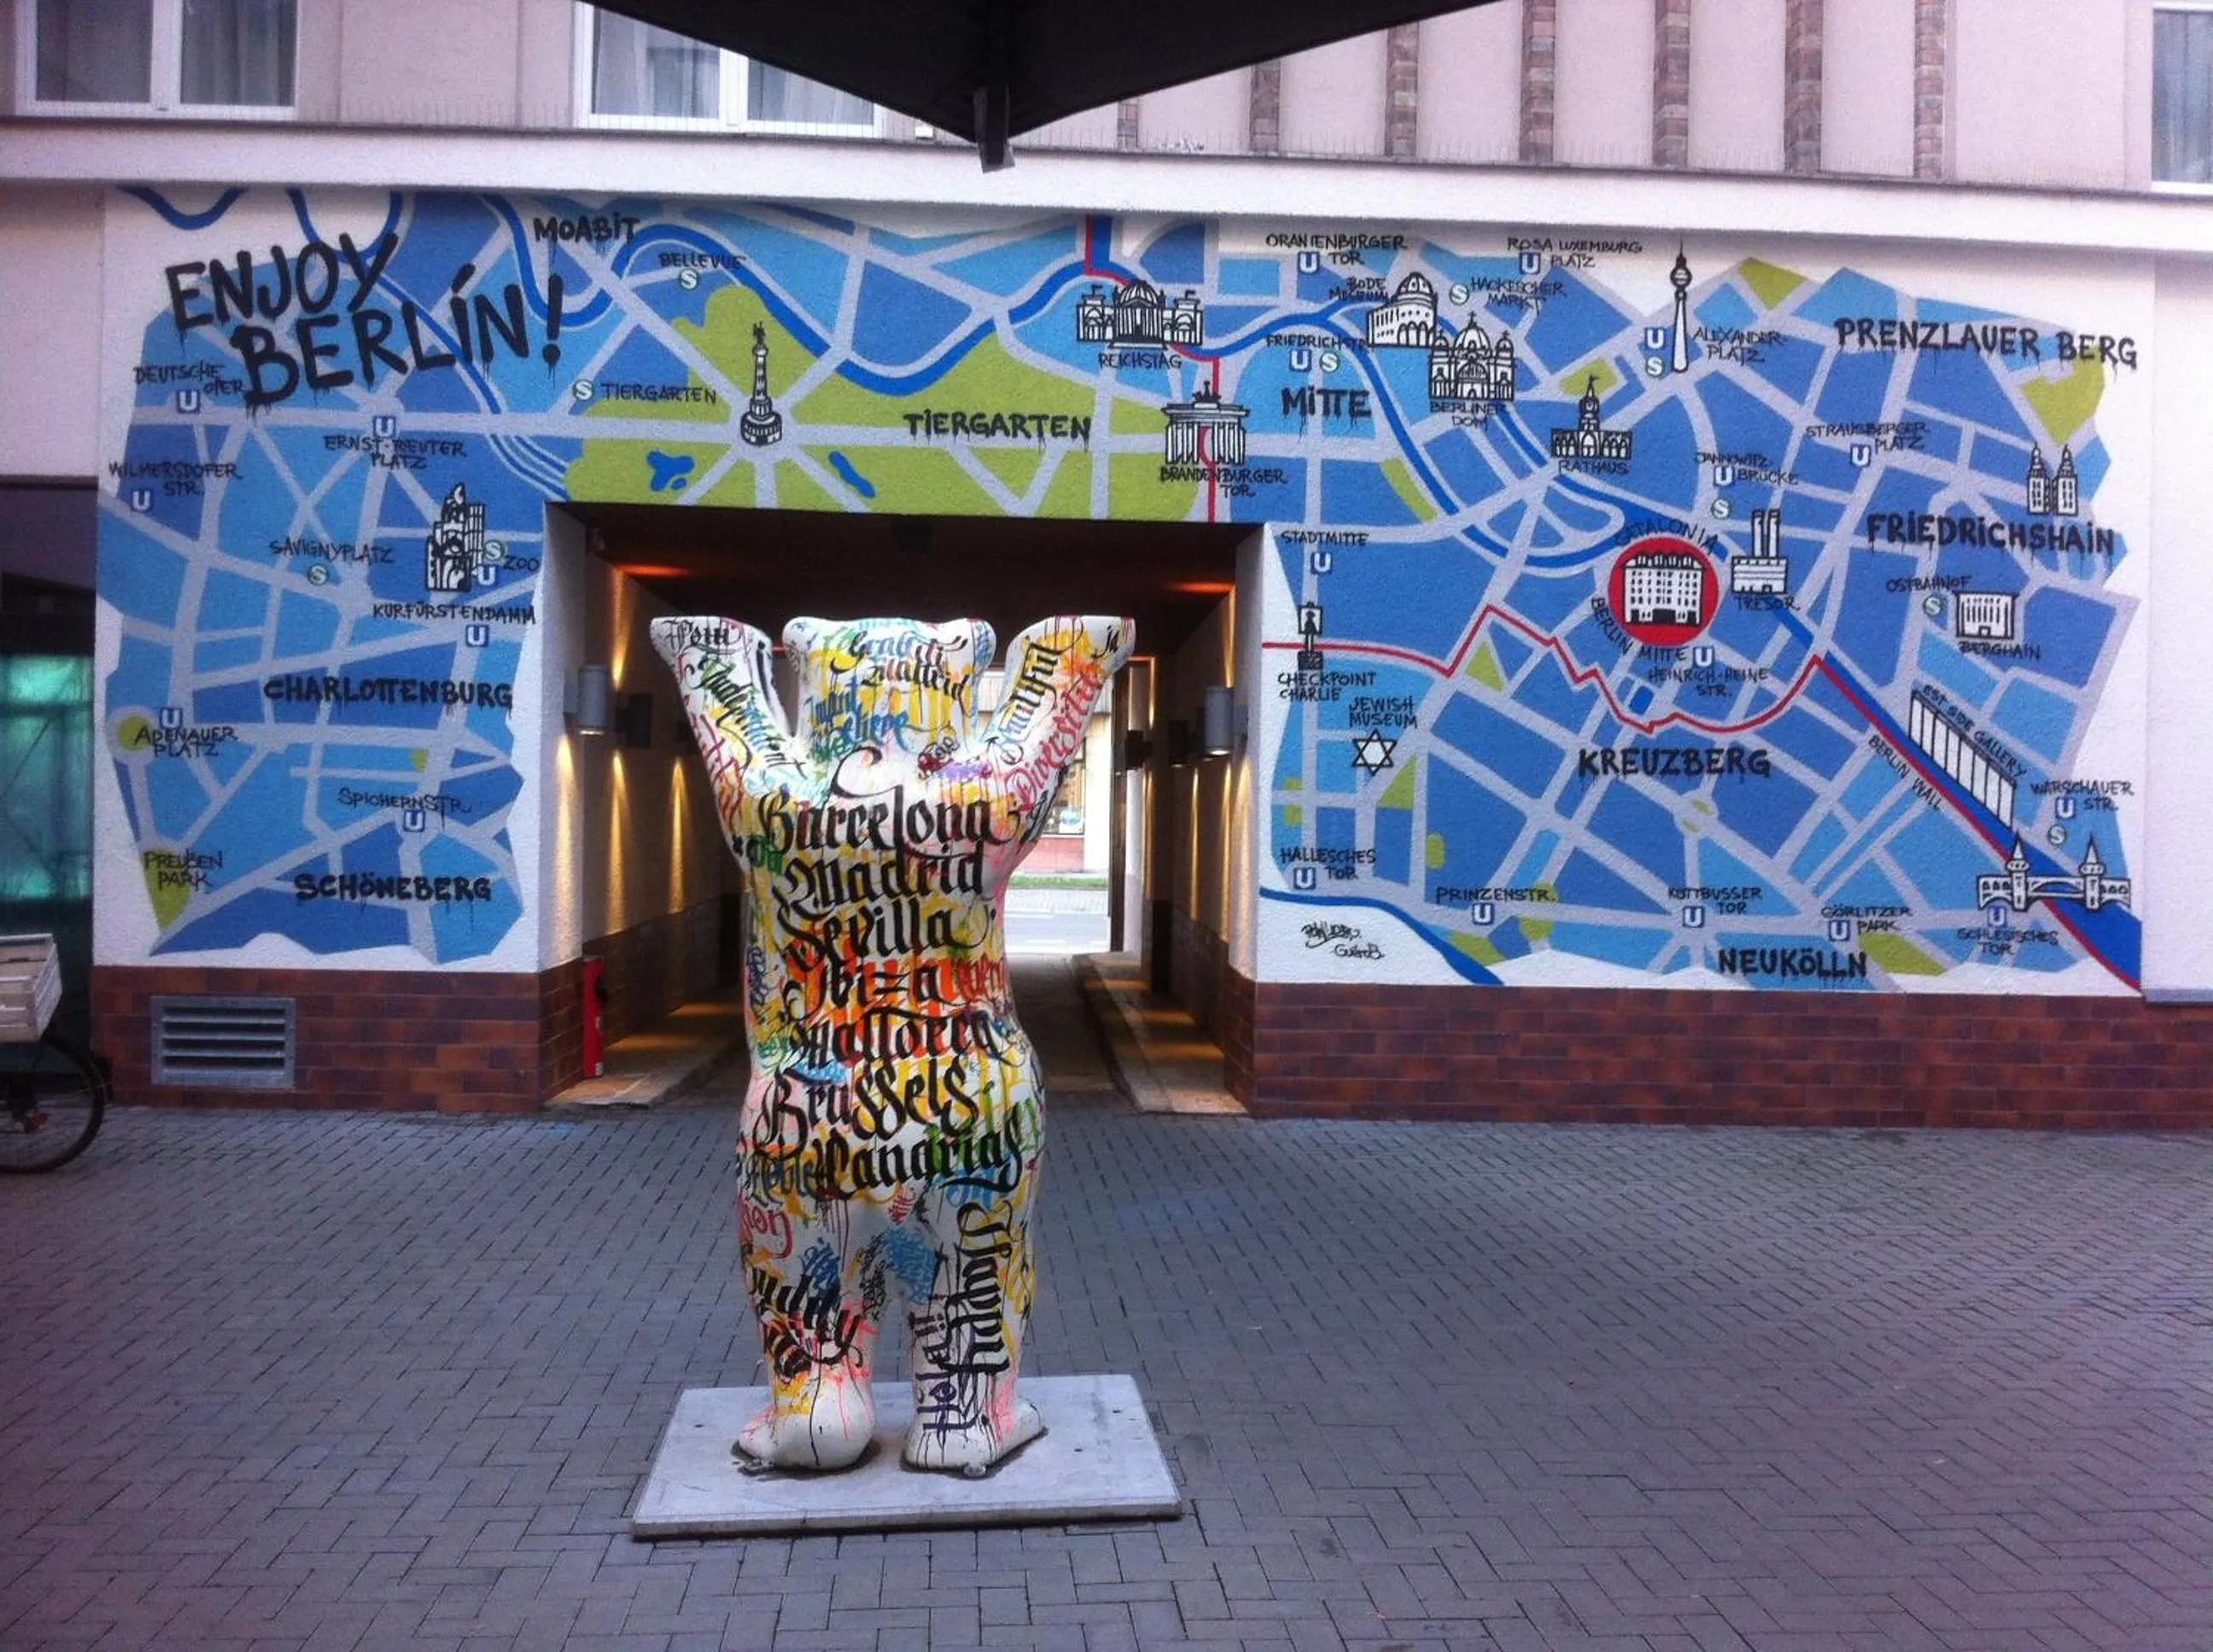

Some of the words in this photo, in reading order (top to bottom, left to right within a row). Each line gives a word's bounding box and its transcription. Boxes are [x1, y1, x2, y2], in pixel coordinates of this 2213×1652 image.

[533, 212, 639, 242] MOABIT
[1265, 232, 1408, 250] ORANIENBURGER
[1507, 236, 1552, 252] ROSA
[1557, 239, 1643, 254] LUXEMBURG
[658, 252, 746, 268] BELLEVUE
[1298, 252, 1319, 274] U
[1328, 252, 1365, 266] TOR
[1519, 252, 1540, 274] U
[1550, 254, 1595, 269] PLATZ
[165, 232, 399, 333] ENJOY
[680, 268, 700, 289] S
[1346, 275, 1387, 291] BODE
[1450, 284, 1469, 305] S
[1645, 328, 1666, 349] U
[1693, 325, 1784, 346] ALEXANDER
[1835, 318, 2040, 359] PRENZLAUER
[2056, 330, 2137, 367] BERG
[1099, 352, 1182, 370] REICHSTAG
[1290, 350, 1311, 371] U
[1319, 352, 1340, 373] S
[1708, 344, 1765, 365] PLATZ
[133, 360, 225, 384] DEUTSCHE
[1645, 357, 1663, 377] S
[574, 380, 593, 400] S
[601, 382, 716, 404] TIERGARTEN
[178, 390, 199, 412] U
[1282, 386, 1371, 417] MITTE
[374, 416, 396, 437] U
[903, 409, 1091, 442] TIERGARTEN
[1451, 415, 1487, 429] DOM
[1875, 435, 1924, 453] PLATZ
[371, 453, 426, 470] PLATZ
[1851, 444, 1871, 467] U
[1159, 466, 1288, 484] BRANDENBURGER
[1558, 460, 1630, 476] RATHAUS
[1714, 466, 1734, 487] U
[131, 489, 152, 511] U
[1220, 484, 1256, 498] TOR
[1712, 499, 1731, 518] S
[1281, 529, 1369, 546] STADTMITTE
[1867, 513, 2115, 555] FRIEDRICHSHAIN
[269, 538, 394, 564] SAVIGNYPLATZ
[485, 540, 505, 560] S
[505, 556, 540, 571] ZOO
[1311, 552, 1332, 574] U
[307, 565, 329, 586] S
[477, 564, 497, 586] U
[373, 603, 536, 625] KURFÜRSTENDAMM
[1923, 595, 1942, 616] S
[466, 625, 488, 647] U
[1591, 597, 1634, 654] BERLIN
[1638, 645, 1687, 661] MITTE
[1693, 646, 1714, 668] U
[1958, 641, 2041, 659] BERGHAIN
[1277, 672, 1376, 686] CHECKPOINT
[264, 675, 513, 708] CHARLOTTENBURG
[1279, 686, 1341, 702] CHARLIE
[1349, 696, 1415, 713] JEWISH
[161, 708, 183, 729] U
[1349, 712, 1417, 728] MUSEUM
[134, 726, 237, 744] ADENAUER
[154, 744, 219, 757] PLATZ
[1579, 747, 1771, 778] KREUZBERG
[1868, 735, 1910, 779] BERLIN
[1912, 778, 1941, 811] WALL
[2030, 780, 2134, 796] WARSCHAUER
[2056, 797, 2076, 819] U
[403, 810, 425, 832] U
[757, 787, 1020, 854] Barcelona
[2047, 824, 2067, 844] S
[1281, 847, 1376, 863] HALLESCHES
[157, 871, 213, 892] PARK
[773, 841, 984, 919] Madrid
[1293, 867, 1316, 889] U
[1324, 867, 1358, 879] TOR
[294, 872, 491, 902] SCHÖNEBERG
[1472, 902, 1493, 925] U
[1683, 906, 1705, 928] U
[1716, 902, 1747, 915] TOR
[1821, 904, 1912, 919] GÖRLITZER
[1988, 905, 2006, 926] U
[777, 896, 990, 971] Sevilla
[1829, 920, 1849, 942] U
[1856, 919, 1901, 935] PARK
[1978, 942, 2014, 955] TOR
[1718, 947, 1867, 978] NEUKÖLLN
